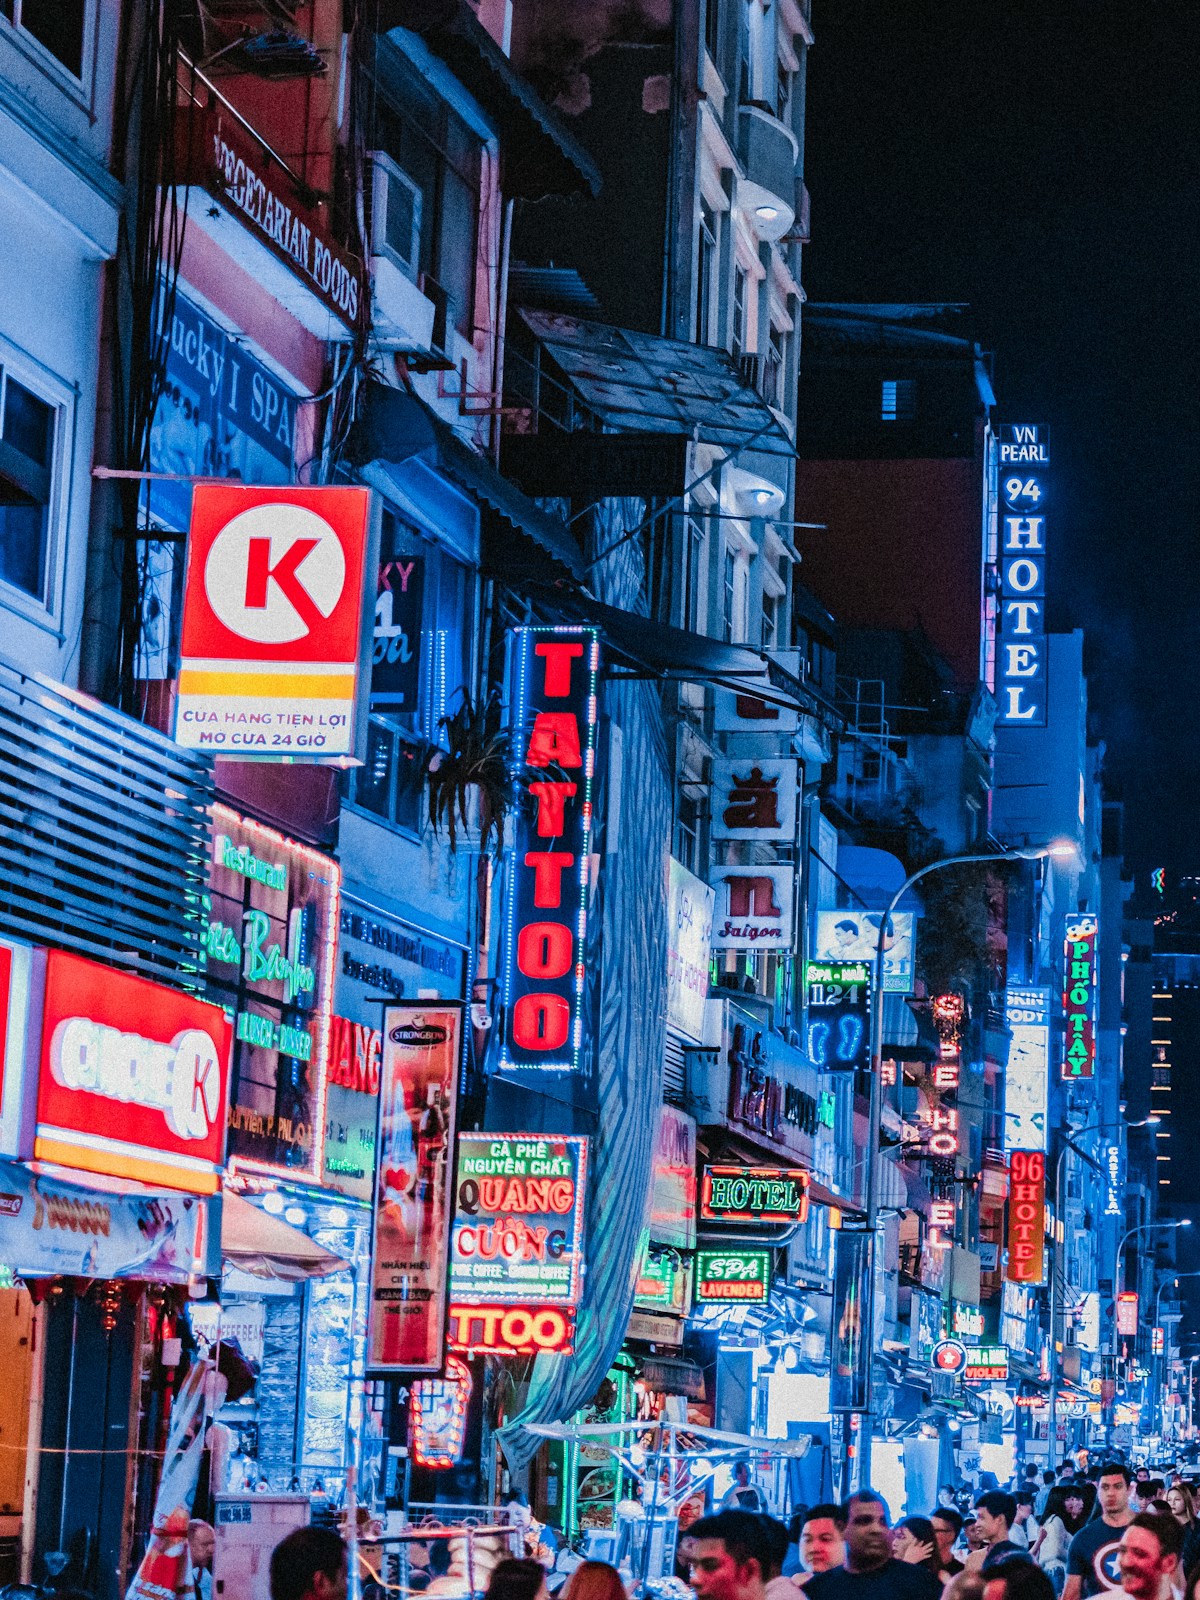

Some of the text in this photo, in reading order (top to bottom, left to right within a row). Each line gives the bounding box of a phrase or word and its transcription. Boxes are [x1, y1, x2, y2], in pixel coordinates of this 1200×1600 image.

[313, 237, 358, 321] FOODS
[251, 372, 291, 448] SPA
[1014, 427, 1036, 443] VN
[1001, 445, 1048, 462] PEARL
[1006, 479, 1041, 502] 94
[1005, 518, 1042, 719] HOTEL
[319, 714, 347, 730] LỢI
[272, 733, 293, 746] 24
[512, 642, 584, 1051] TATTOO
[223, 835, 287, 891] Restaurant
[718, 922, 782, 941] Saigon
[244, 909, 315, 1003] Bamboo
[1069, 942, 1091, 1005] PHỐ
[1006, 991, 1044, 1007] SKIN
[238, 1012, 274, 1049] LUNCH
[394, 1030, 444, 1040] STRONGBOW
[1067, 1013, 1089, 1075] TÂY
[515, 1141, 547, 1158] PHÊ
[463, 1157, 526, 1175] NGUYÊN
[1011, 1152, 1043, 1183] 96
[459, 1176, 575, 1216] QUANG
[709, 1178, 800, 1212] HOTEL
[457, 1215, 566, 1261] CƯỜNG
[1013, 1184, 1039, 1280] HOTEL
[706, 1258, 759, 1279] SPA
[701, 1281, 764, 1297] LAVENDER
[966, 1368, 1007, 1378] VIOLET
